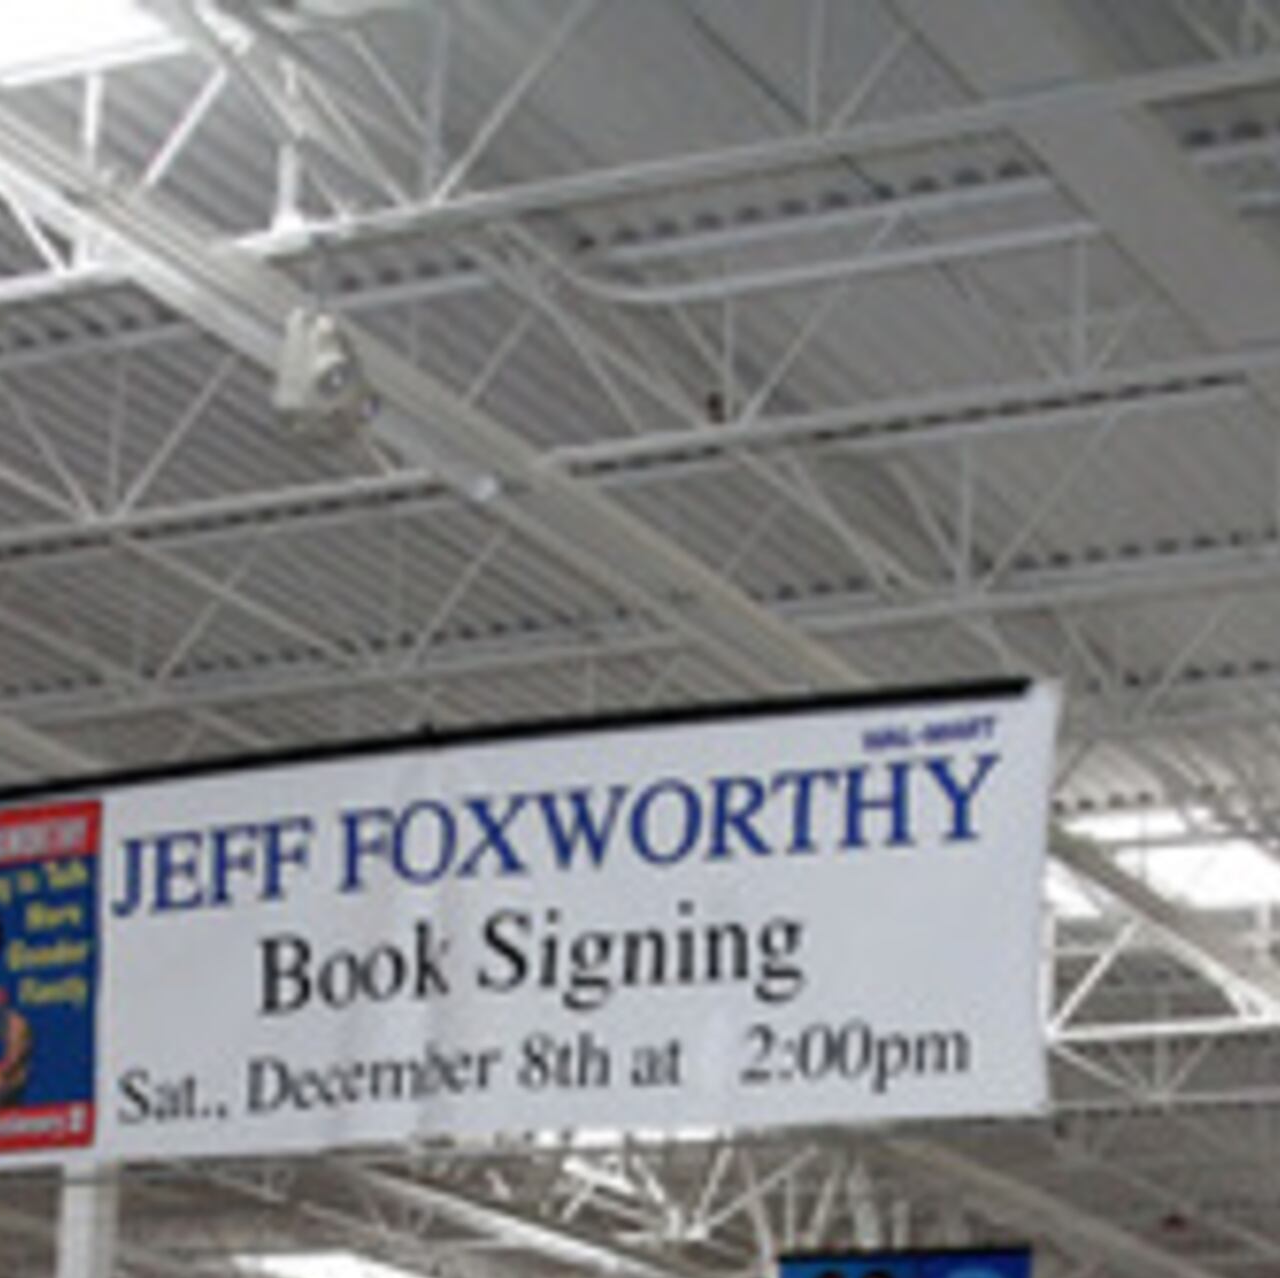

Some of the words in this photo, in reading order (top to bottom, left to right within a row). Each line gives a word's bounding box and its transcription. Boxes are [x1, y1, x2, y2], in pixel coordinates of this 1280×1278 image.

[109, 815, 315, 919] JEFF
[337, 751, 1004, 887] FOXWORTHY
[255, 911, 453, 1018] Book
[476, 898, 806, 1013] Signing
[246, 1038, 502, 1115] December
[517, 1029, 611, 1092] 8th
[631, 1038, 682, 1088] at
[740, 1020, 972, 1095] 2:00pm
